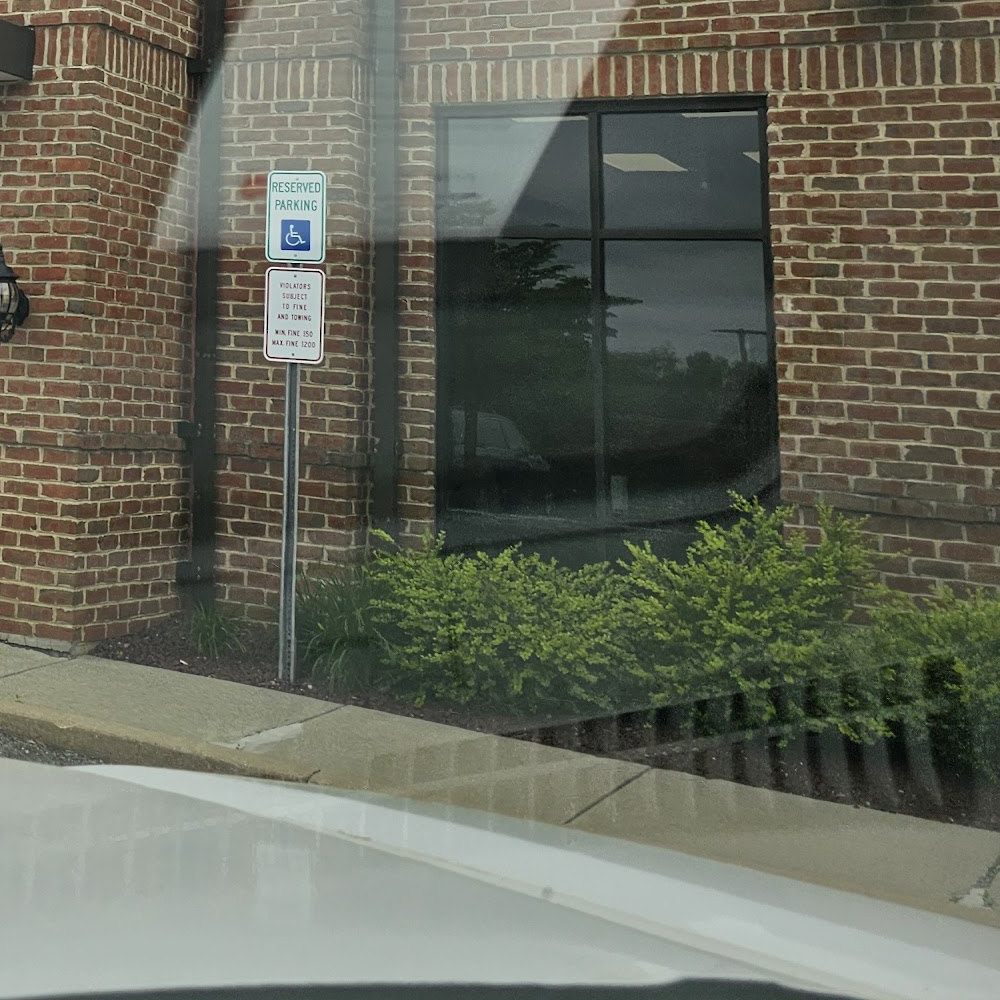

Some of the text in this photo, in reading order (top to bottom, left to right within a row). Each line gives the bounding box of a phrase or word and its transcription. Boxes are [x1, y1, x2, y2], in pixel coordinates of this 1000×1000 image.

[272, 182, 320, 193] RESERVED
[275, 200, 317, 211] PARKING
[280, 282, 311, 290] VIOLATORS
[288, 329, 300, 337] FINE
